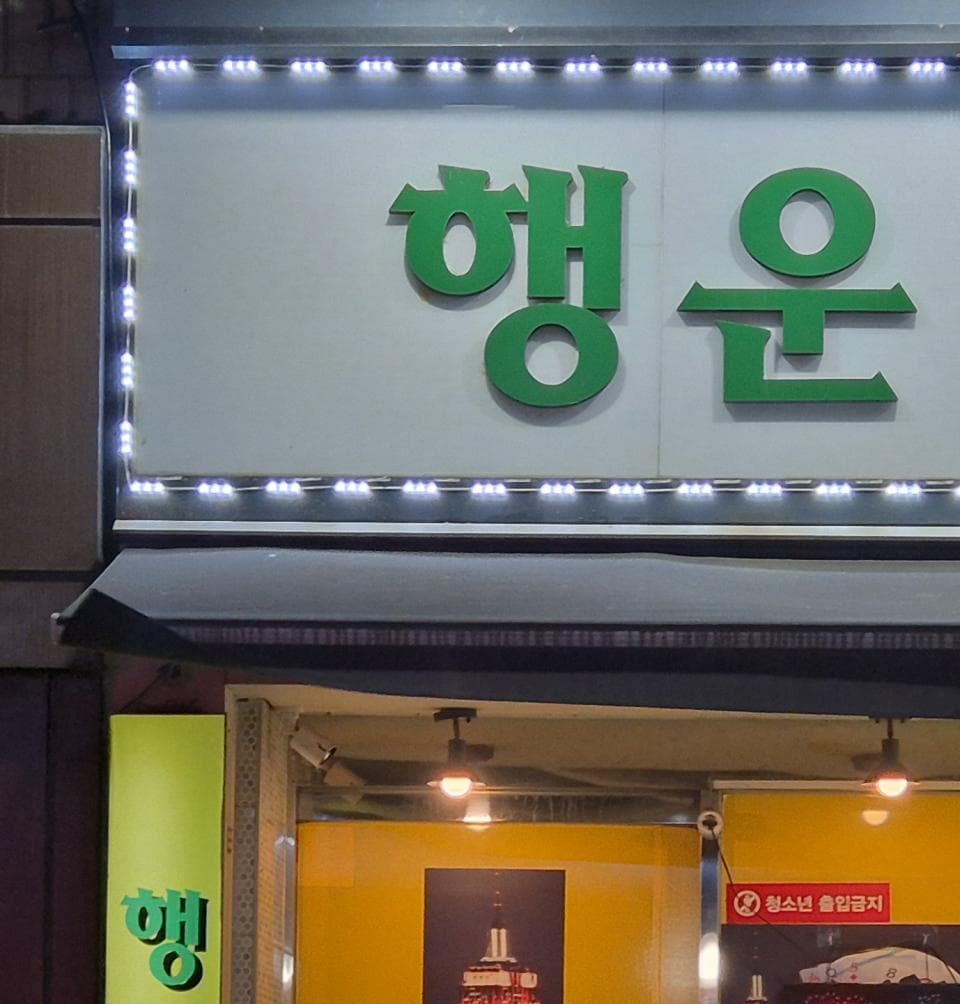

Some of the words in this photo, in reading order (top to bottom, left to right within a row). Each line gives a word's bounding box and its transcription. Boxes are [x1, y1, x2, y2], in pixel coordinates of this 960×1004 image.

[388, 165, 917, 406] 행운
[764, 894, 813, 913] 청소년
[818, 894, 883, 913] 출입금지
